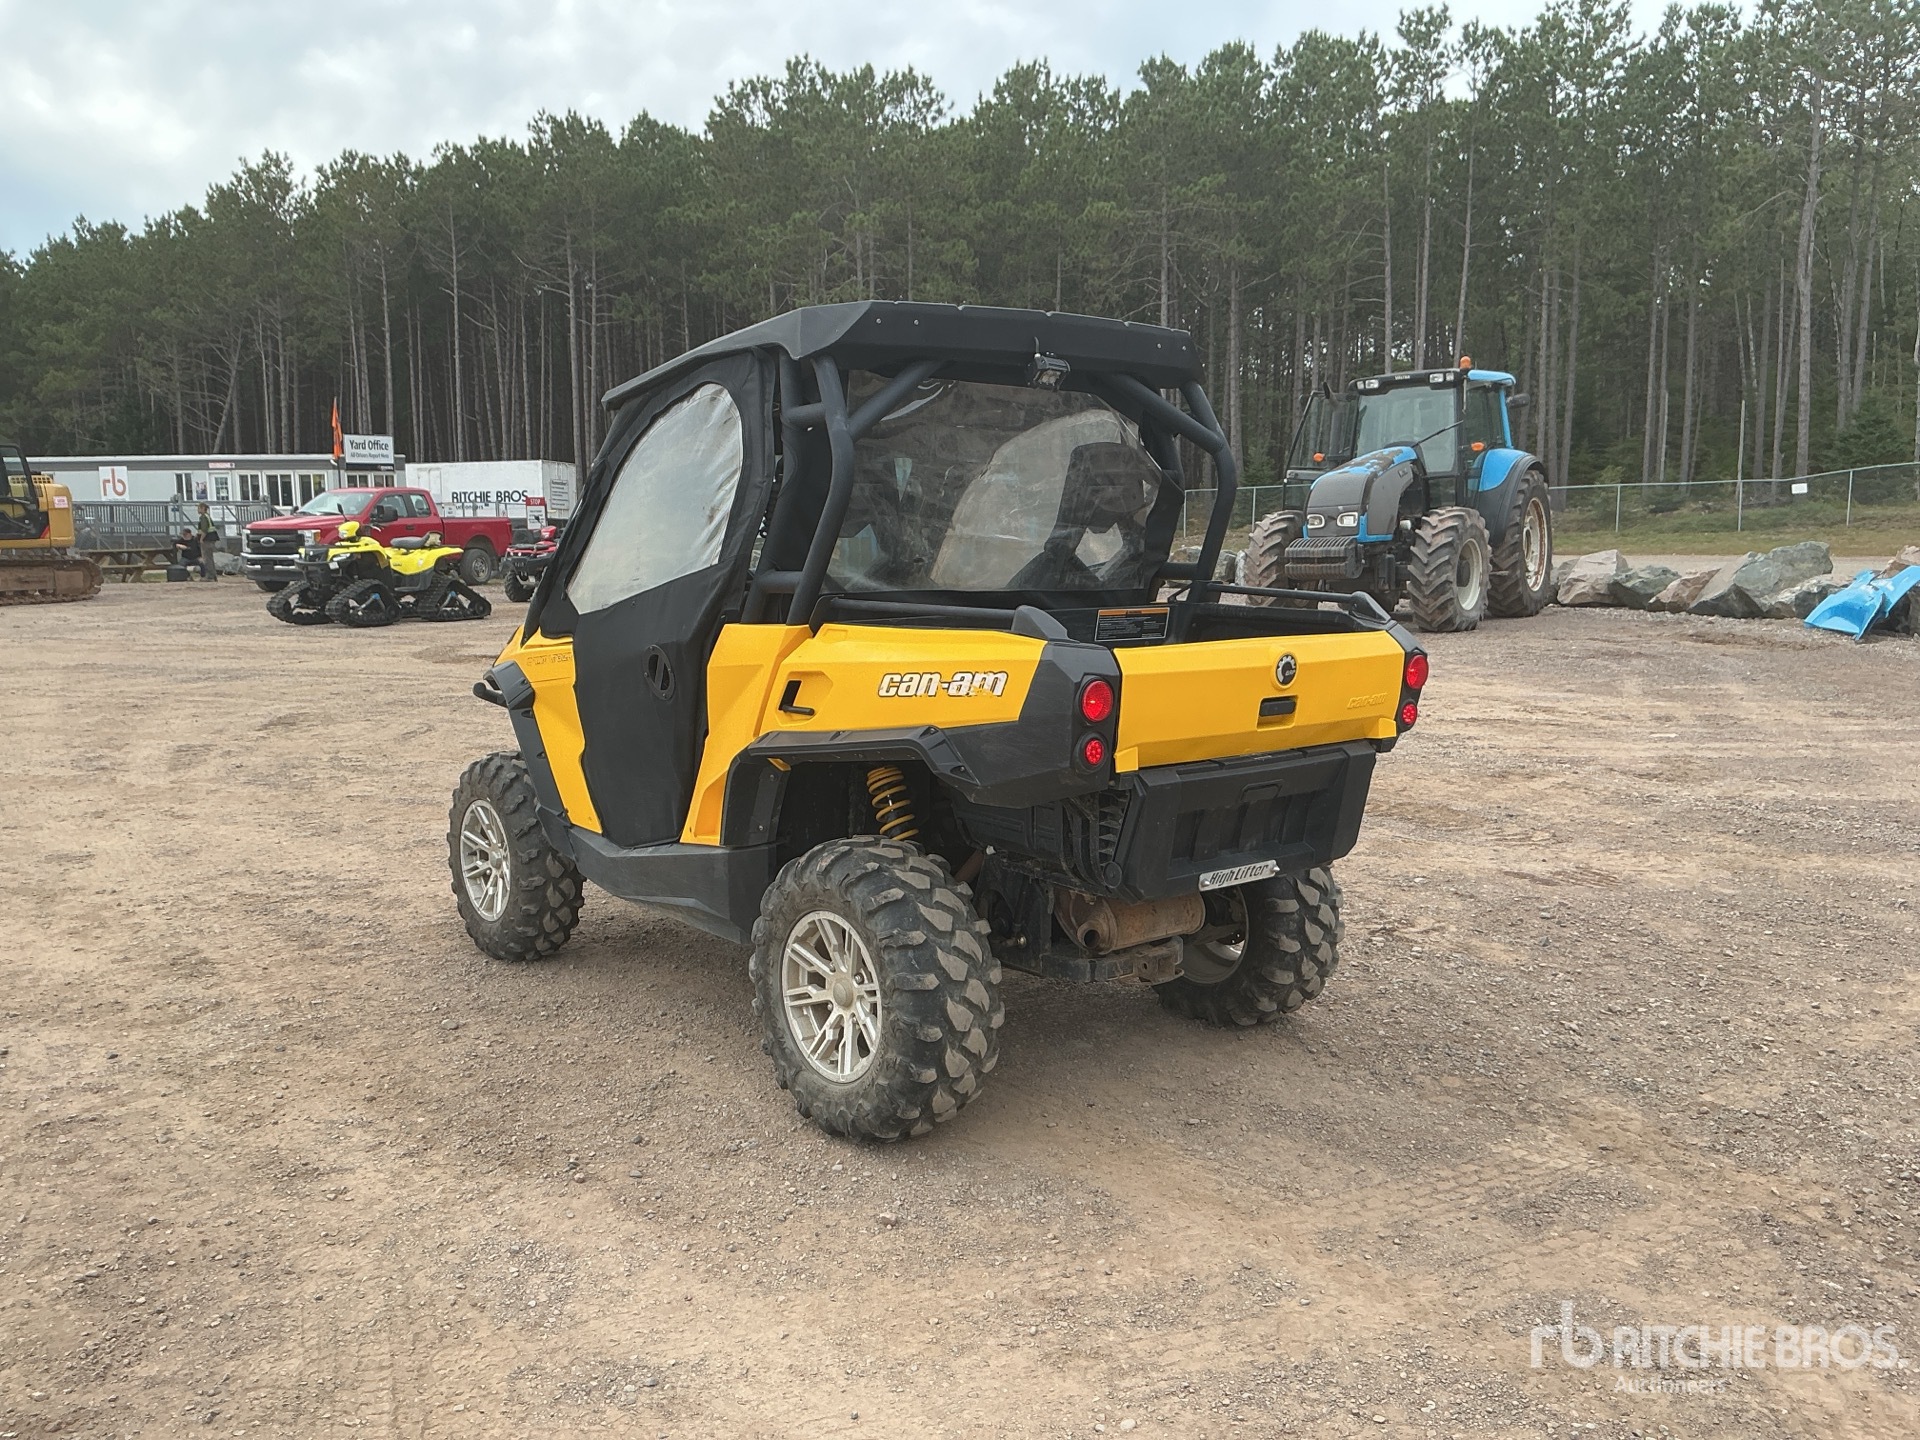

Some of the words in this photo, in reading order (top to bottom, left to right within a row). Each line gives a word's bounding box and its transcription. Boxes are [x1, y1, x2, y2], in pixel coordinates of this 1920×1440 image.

[349, 439, 366, 450] Yard
[368, 439, 389, 451] Office
[102, 468, 127, 497] rb
[451, 491, 491, 504] RITCHIE
[496, 490, 528, 504] BROS
[877, 671, 1009, 698] can-am
